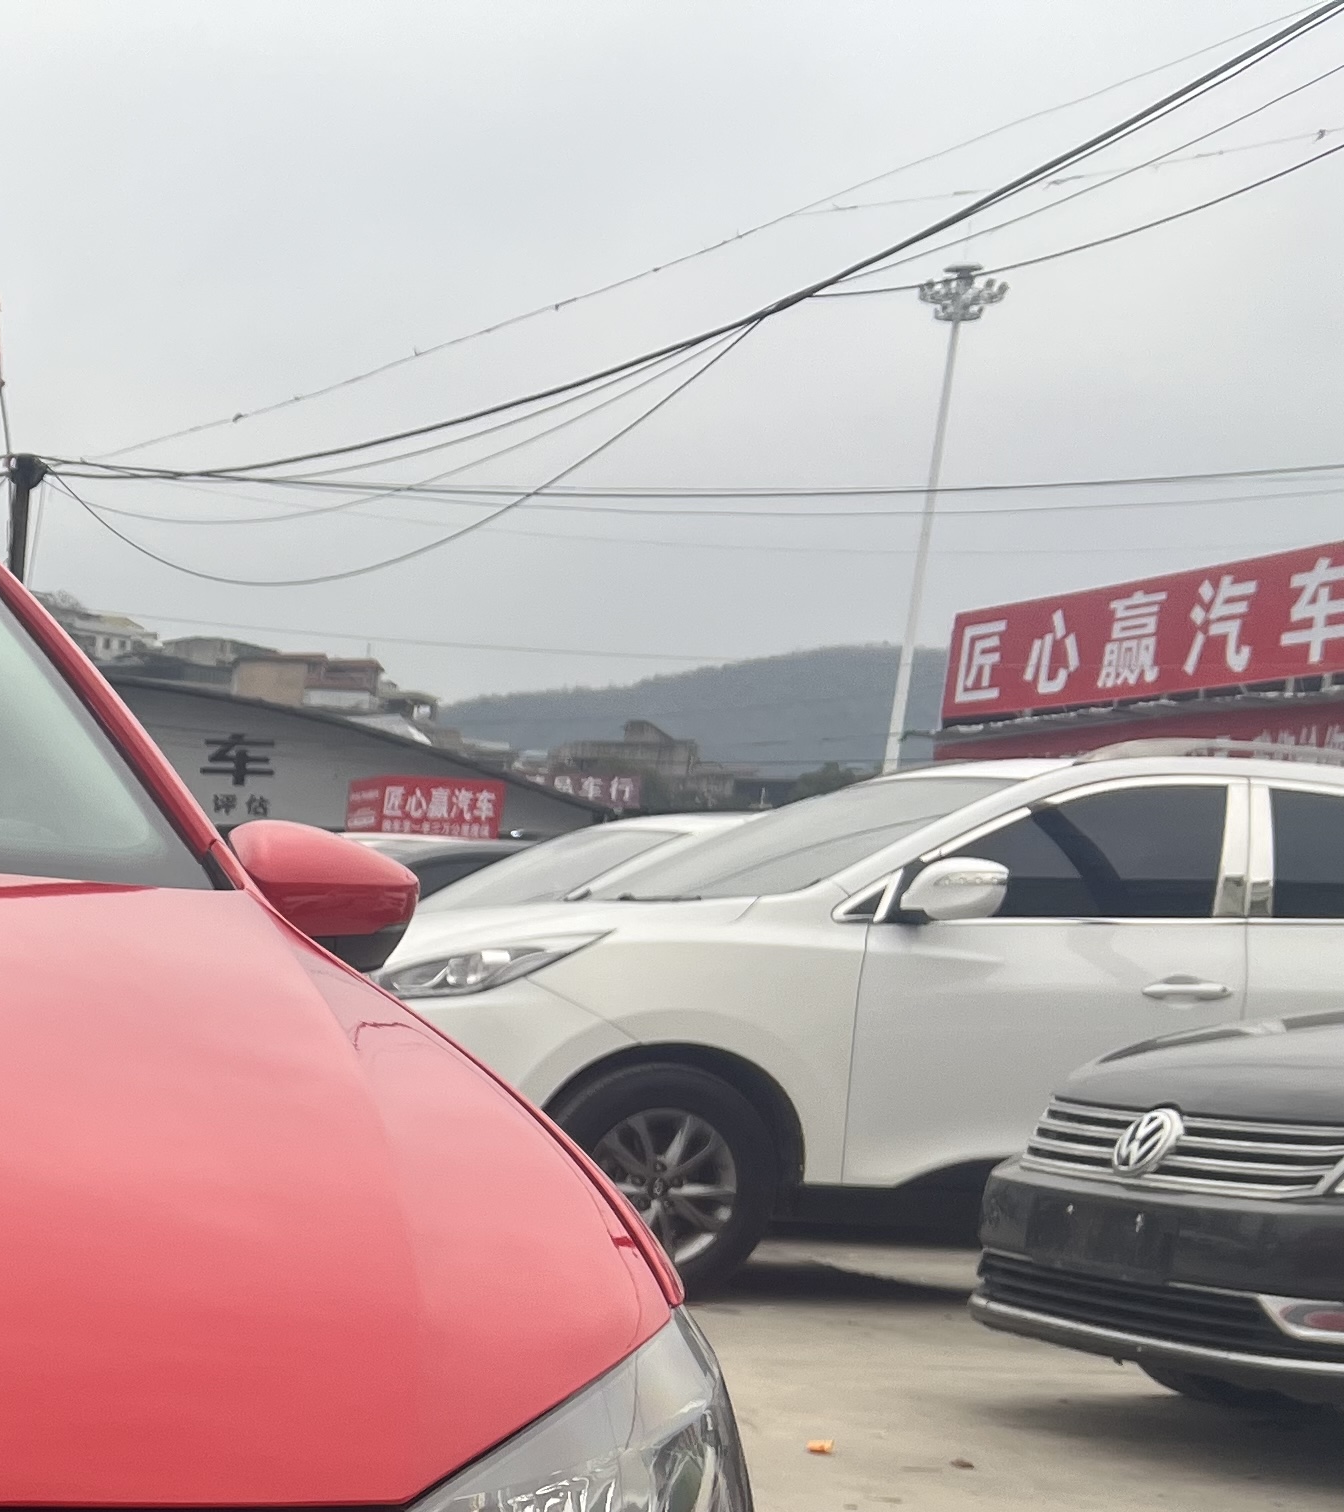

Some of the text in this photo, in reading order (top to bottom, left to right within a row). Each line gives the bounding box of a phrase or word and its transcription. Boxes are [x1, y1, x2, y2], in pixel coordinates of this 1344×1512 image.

[954, 557, 1344, 704] 匠心赢汽车
[199, 733, 275, 787] 车
[383, 786, 497, 821] 匠心赢汽车
